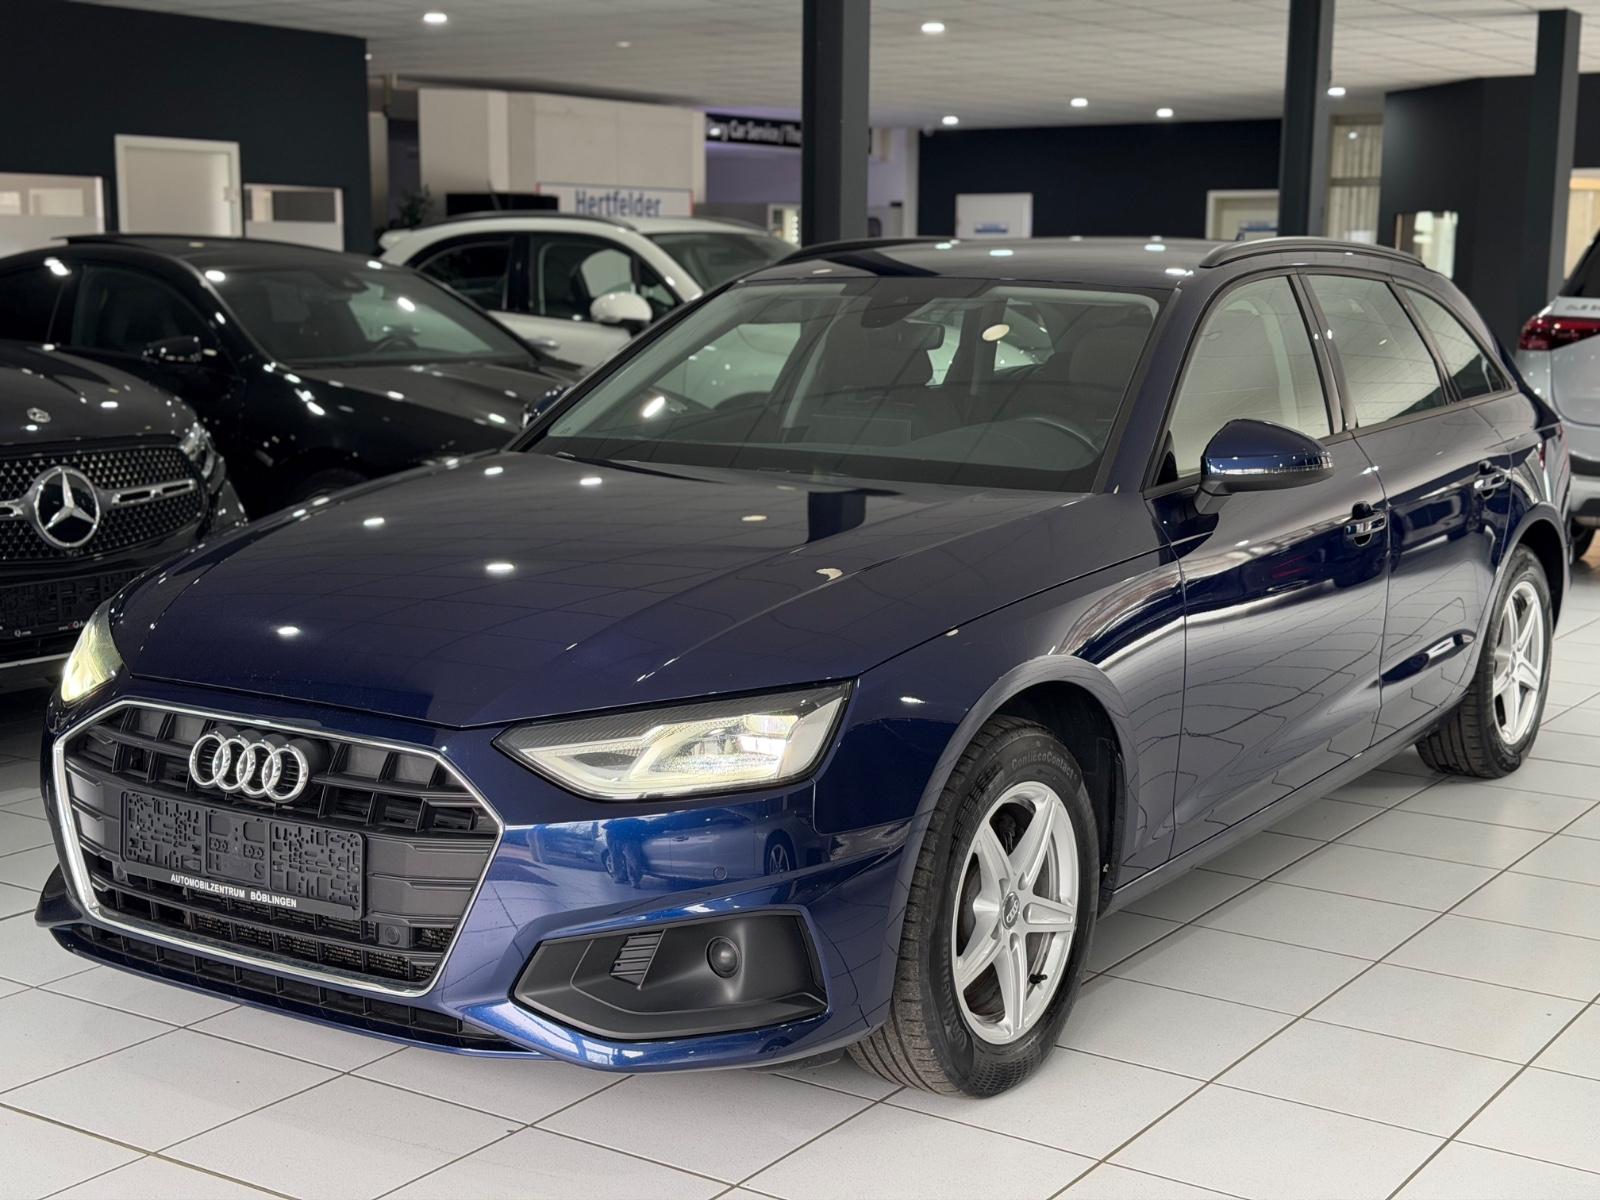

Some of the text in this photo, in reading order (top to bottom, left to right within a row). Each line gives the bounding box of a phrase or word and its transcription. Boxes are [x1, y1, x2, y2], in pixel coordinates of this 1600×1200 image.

[729, 119, 746, 140] Car
[575, 190, 661, 218] Hertfelder
[170, 873, 297, 908] AUTOMOBILZENTRUM BÖBLINGEN
